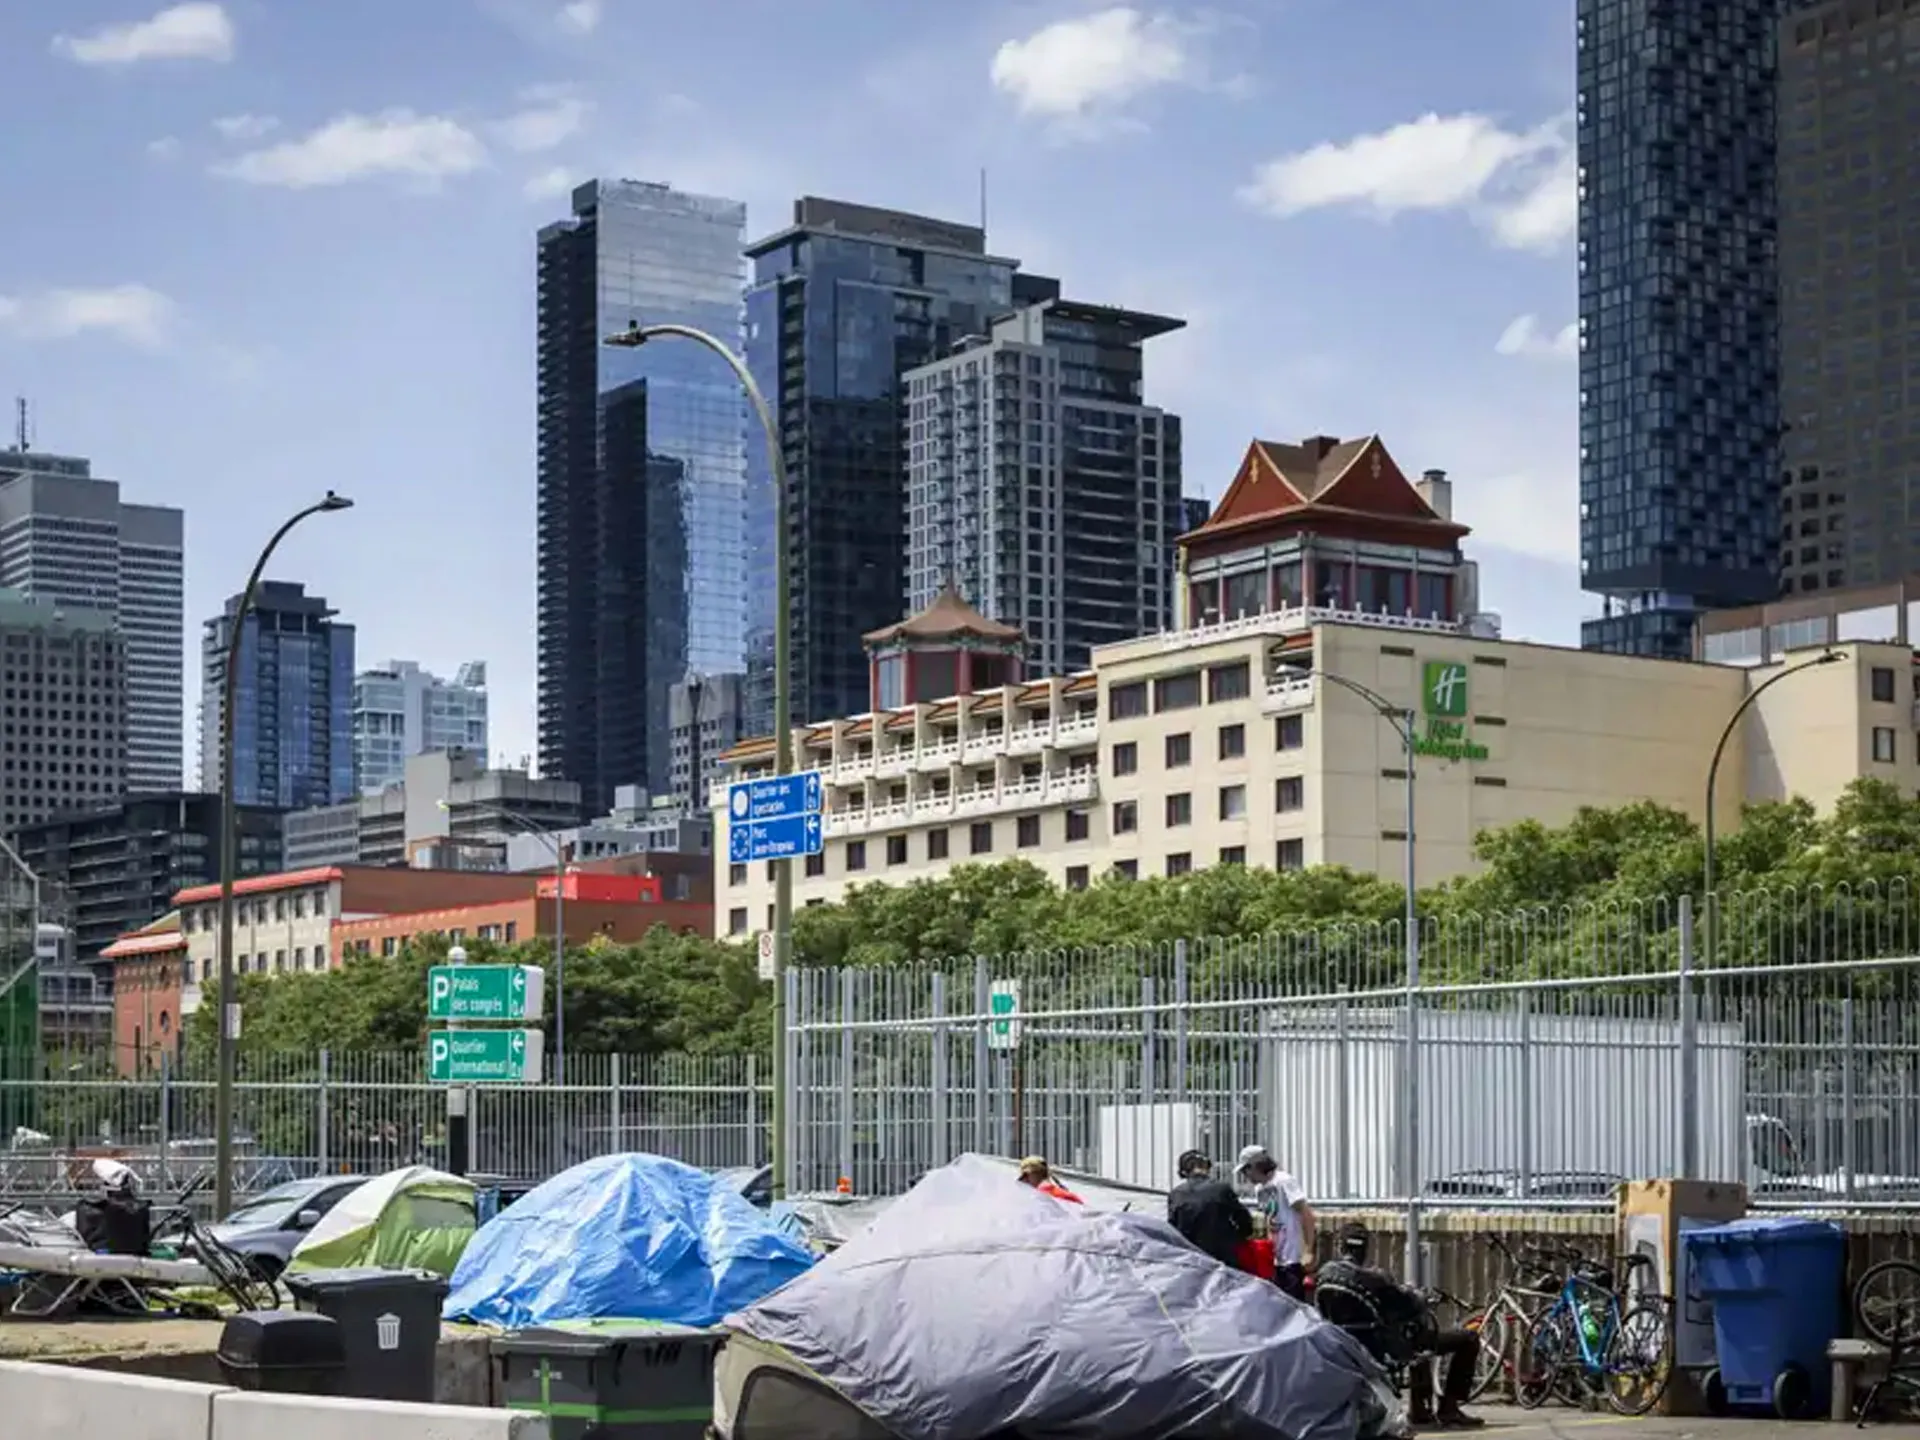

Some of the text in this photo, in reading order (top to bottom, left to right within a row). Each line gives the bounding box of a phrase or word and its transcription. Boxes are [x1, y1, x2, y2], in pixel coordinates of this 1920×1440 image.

[452, 975, 479, 992] Palais
[433, 976, 450, 1012] P
[451, 996, 503, 1017] des congrès
[451, 1039, 487, 1054] Quartier
[432, 1039, 449, 1075] P
[451, 1060, 507, 1073] International
